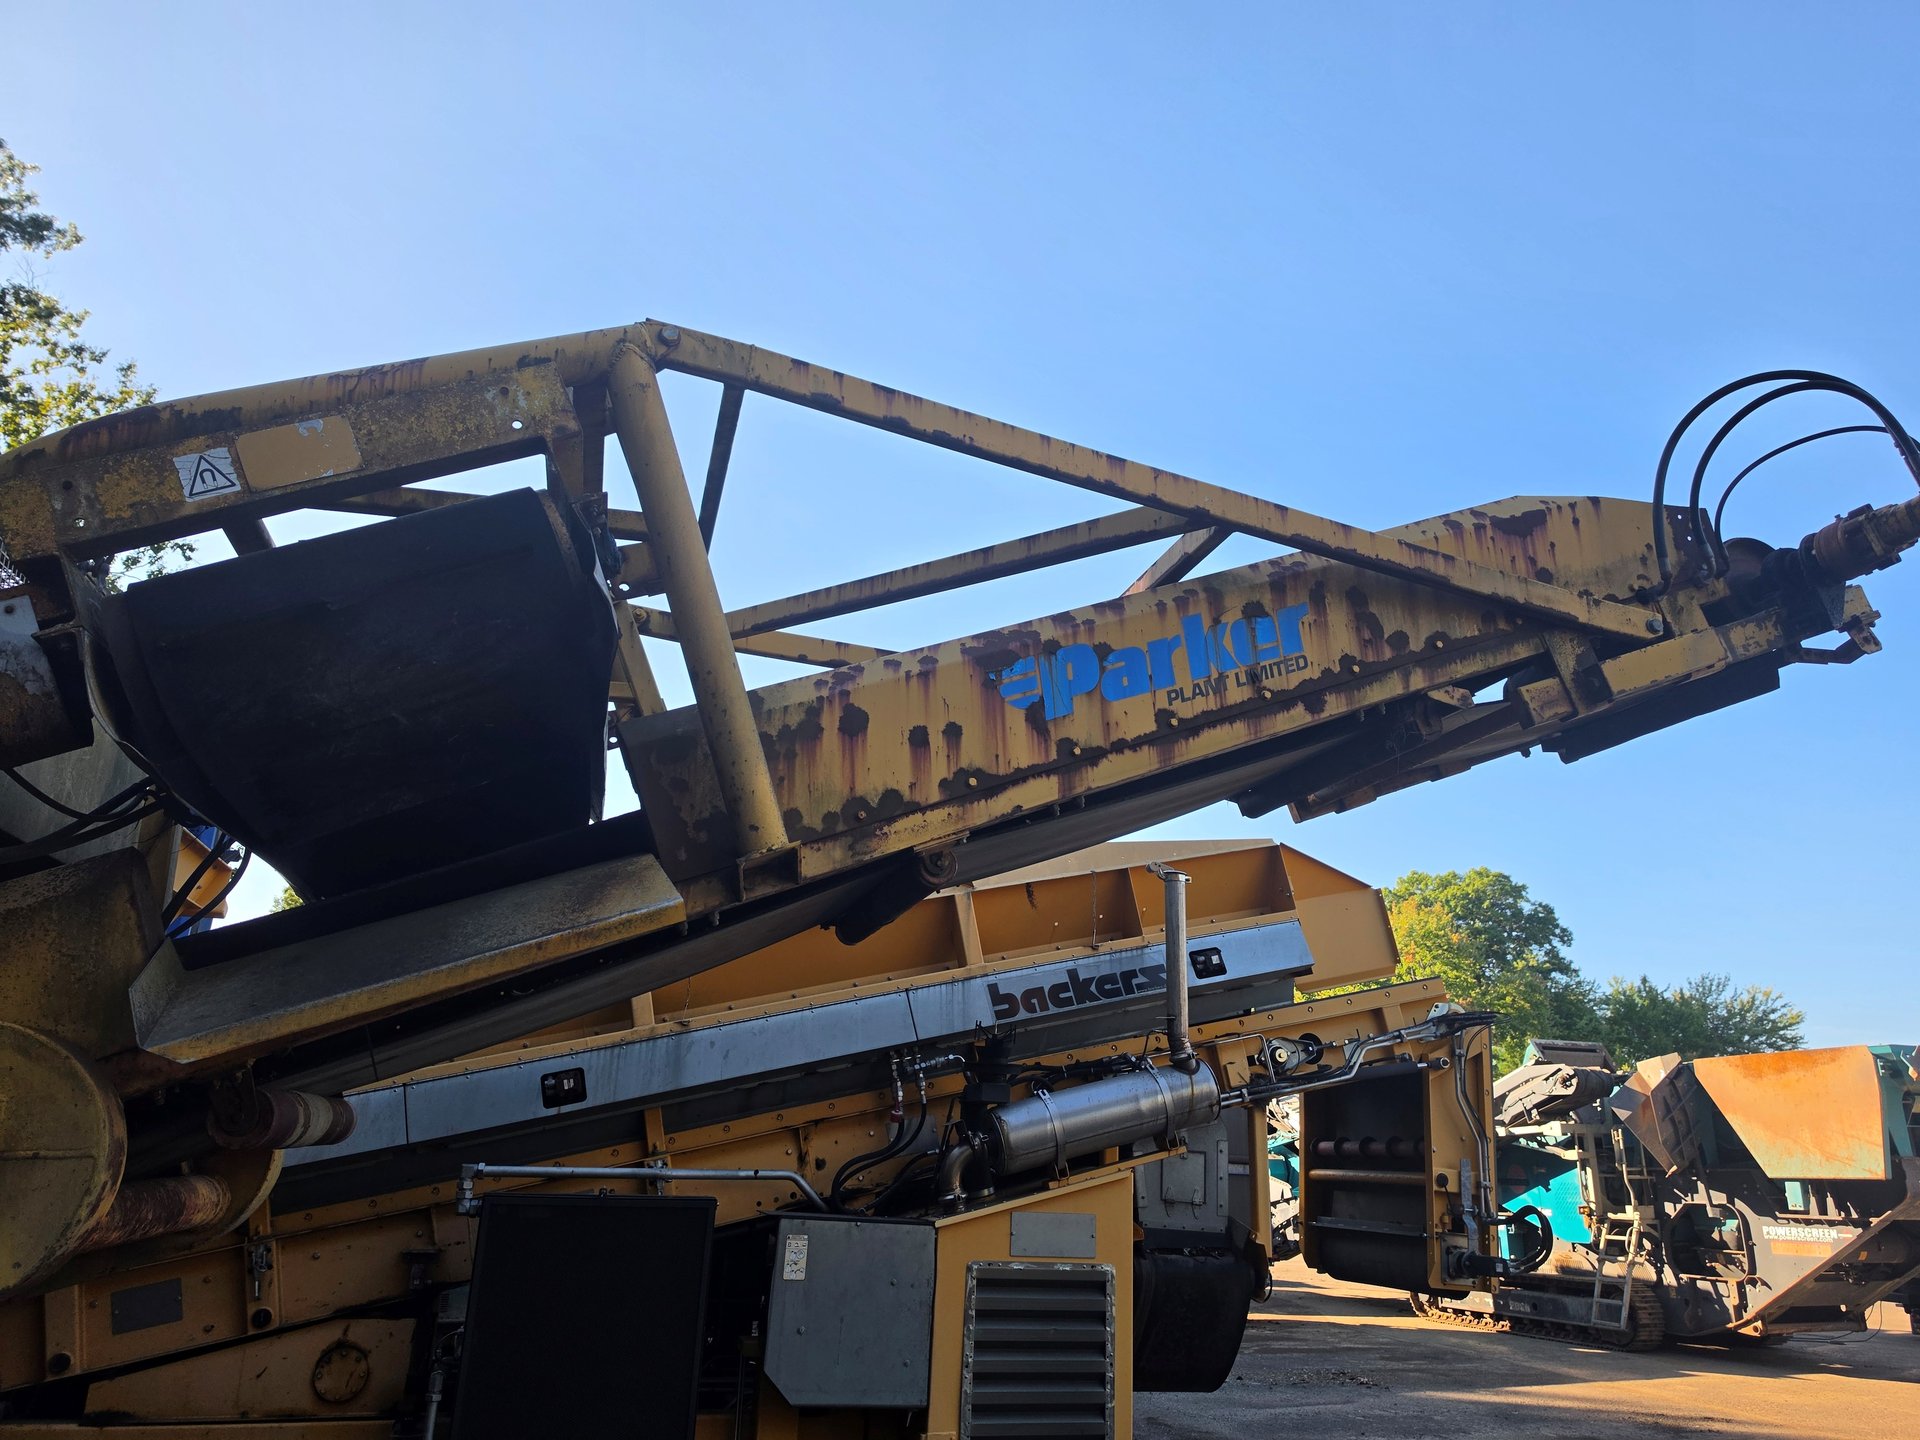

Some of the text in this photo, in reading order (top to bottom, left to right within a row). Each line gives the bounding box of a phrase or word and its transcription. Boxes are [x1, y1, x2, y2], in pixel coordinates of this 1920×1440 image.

[1037, 602, 1309, 721] parker
[1167, 655, 1309, 706] PLANT LIMITED
[987, 963, 1167, 1020] backers
[1762, 1225, 1838, 1239] POWERSCREEN
[1763, 1234, 1834, 1244] www.powerscreen.com
